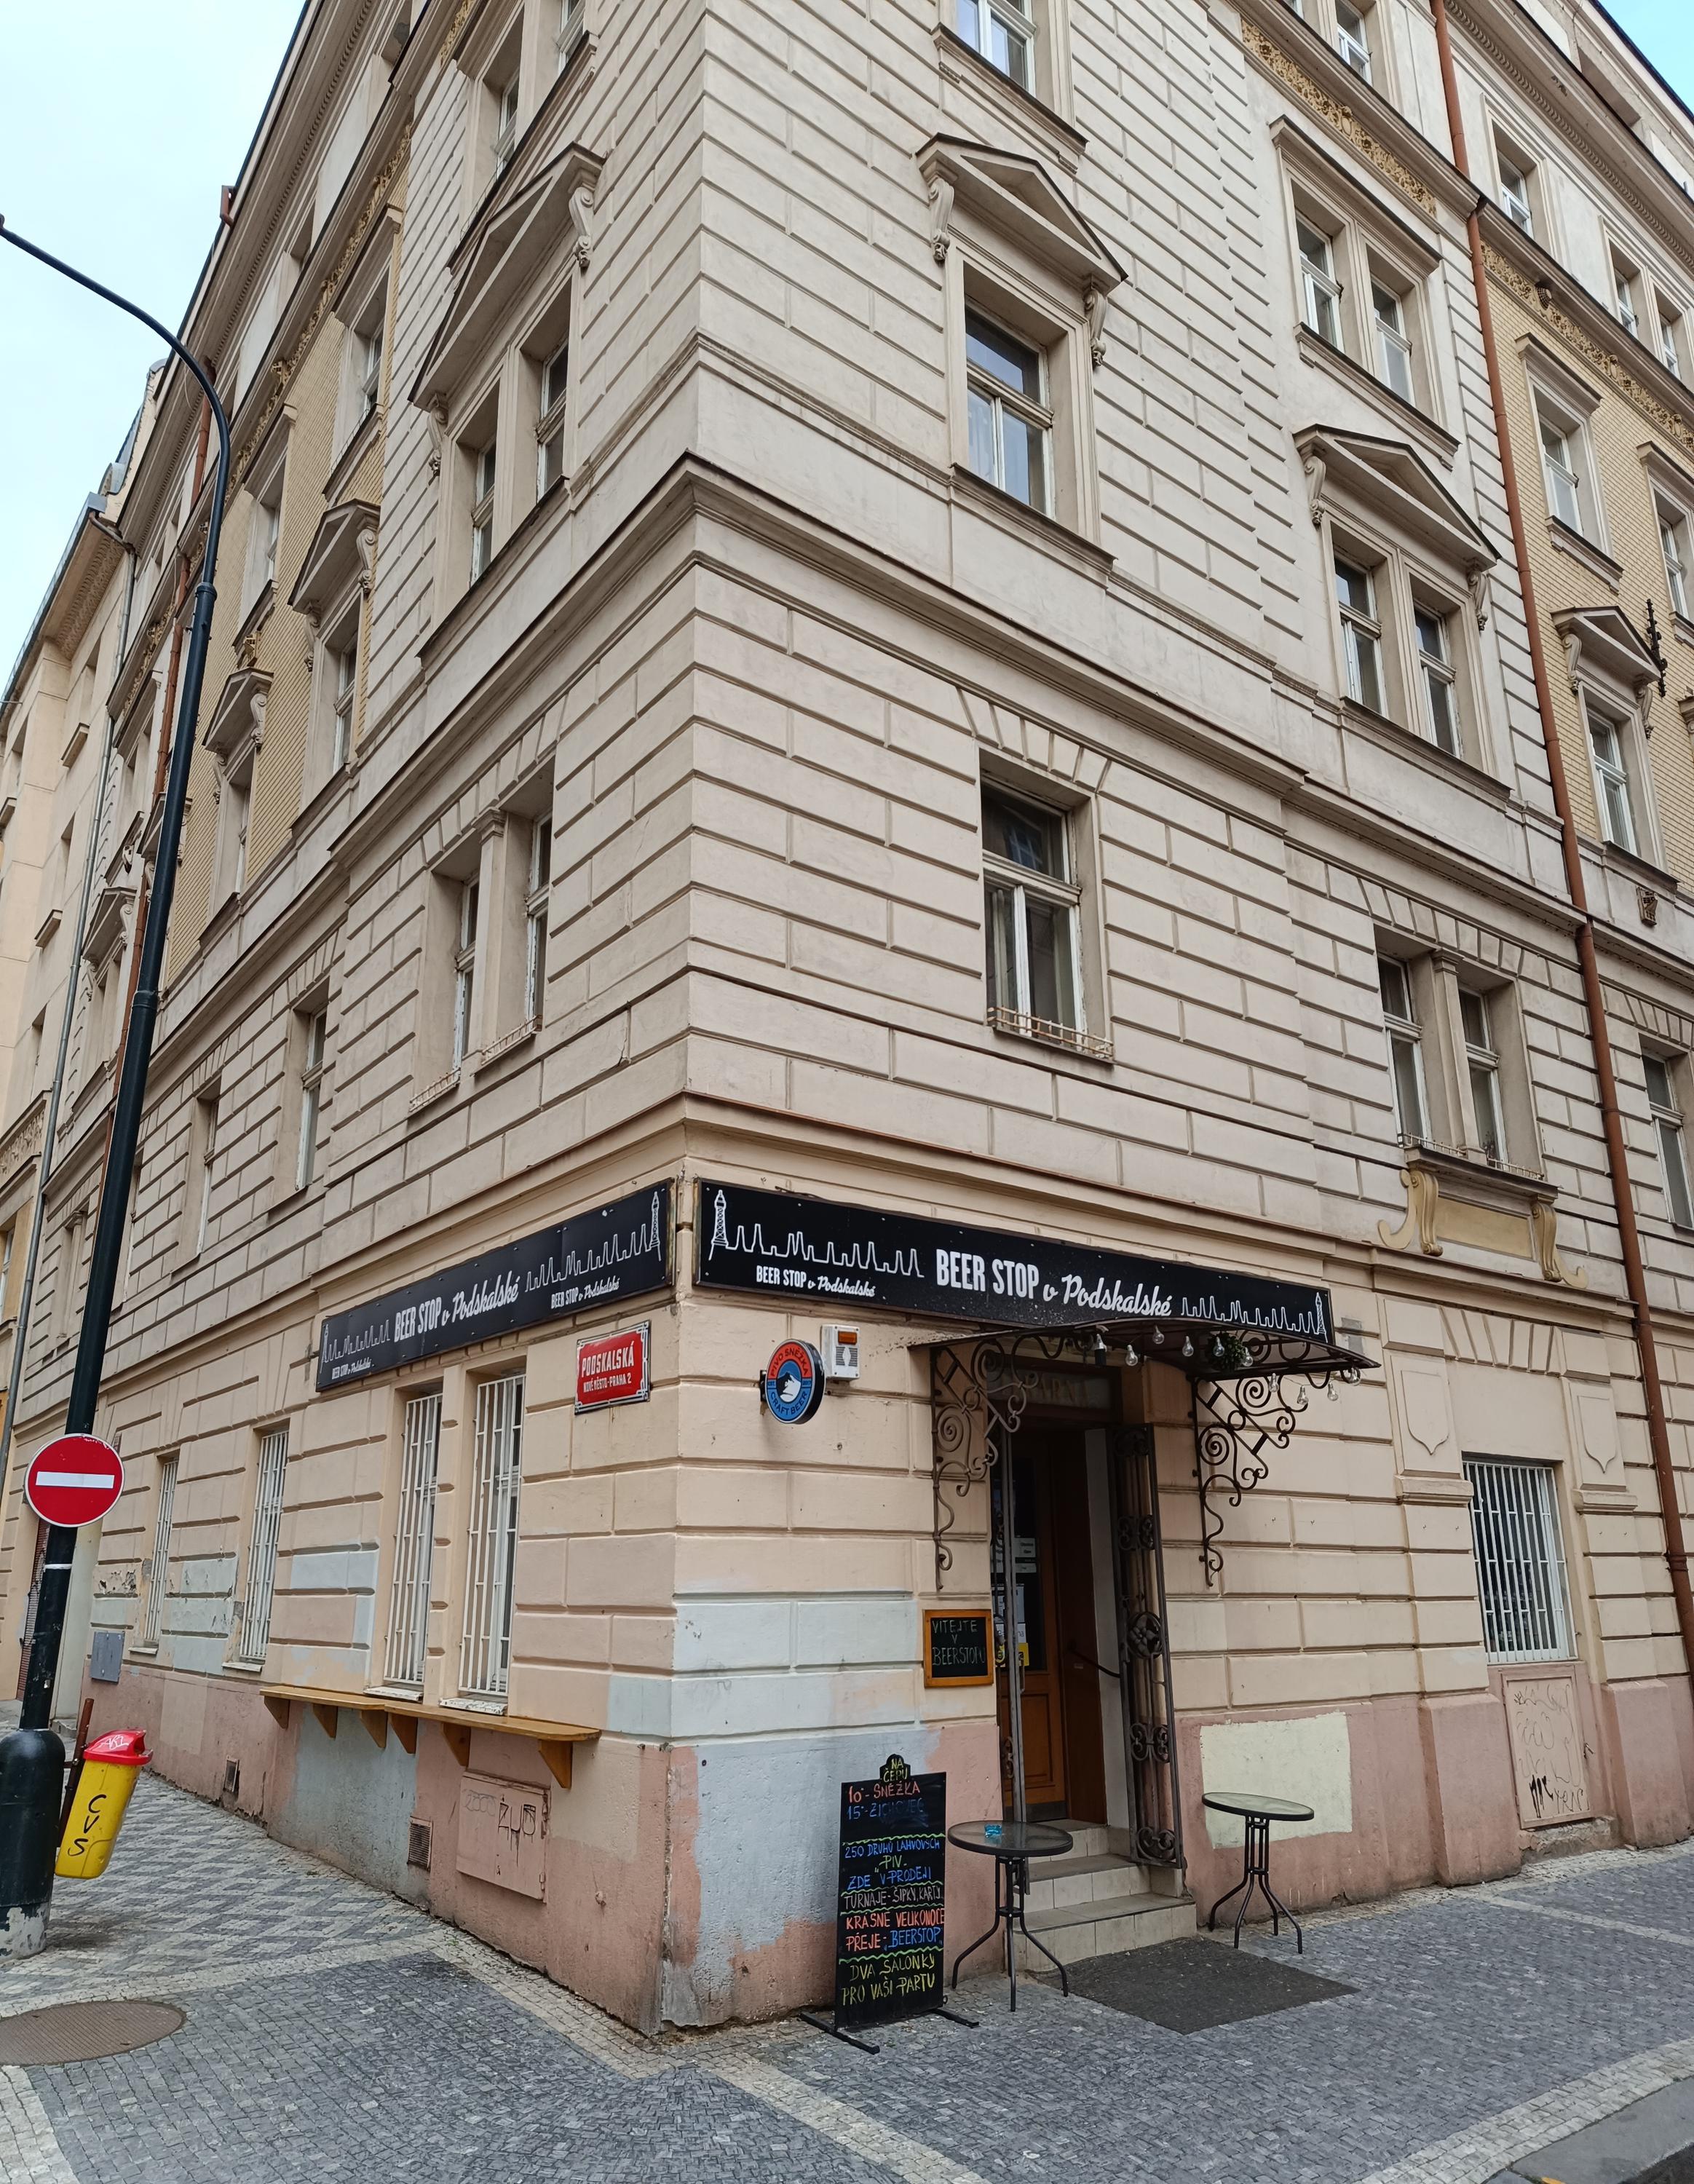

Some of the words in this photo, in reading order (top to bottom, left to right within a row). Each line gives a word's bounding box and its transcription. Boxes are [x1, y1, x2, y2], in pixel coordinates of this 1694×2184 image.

[756, 1265, 780, 1285] BEER
[783, 1269, 807, 1288] STOP
[807, 1280, 816, 1289] v
[817, 1275, 876, 1298] Podskalské
[936, 1249, 986, 1292] BEER
[992, 1259, 1040, 1299] STOP
[1042, 1283, 1058, 1302] v
[1061, 1273, 1173, 1317] Podskalské
[394, 1306, 416, 1342] BEER
[417, 1297, 442, 1334] STOP
[441, 1310, 451, 1326] v
[451, 1270, 521, 1323] Podskalské
[551, 1291, 565, 1309] BEER
[565, 1287, 579, 1305] STOP
[581, 1340, 634, 1378] PODSKALSKÁ
[770, 1353, 784, 1377] PIVO
[627, 1372, 632, 1384] 2
[770, 1391, 790, 1416] CRAFT
[791, 1390, 808, 1415] BEER
[883, 1767, 908, 1782] ČEPU
[891, 1758, 903, 1769] NA
[844, 1845, 864, 1858] 250
[847, 1875, 871, 1891] ZDE
[850, 1963, 876, 1981] DVA
[879, 1952, 935, 1975] SALONKY
[842, 1984, 866, 2006] PRO
[870, 1976, 893, 2000] VAŠI
[895, 1972, 935, 1997] PARTU
